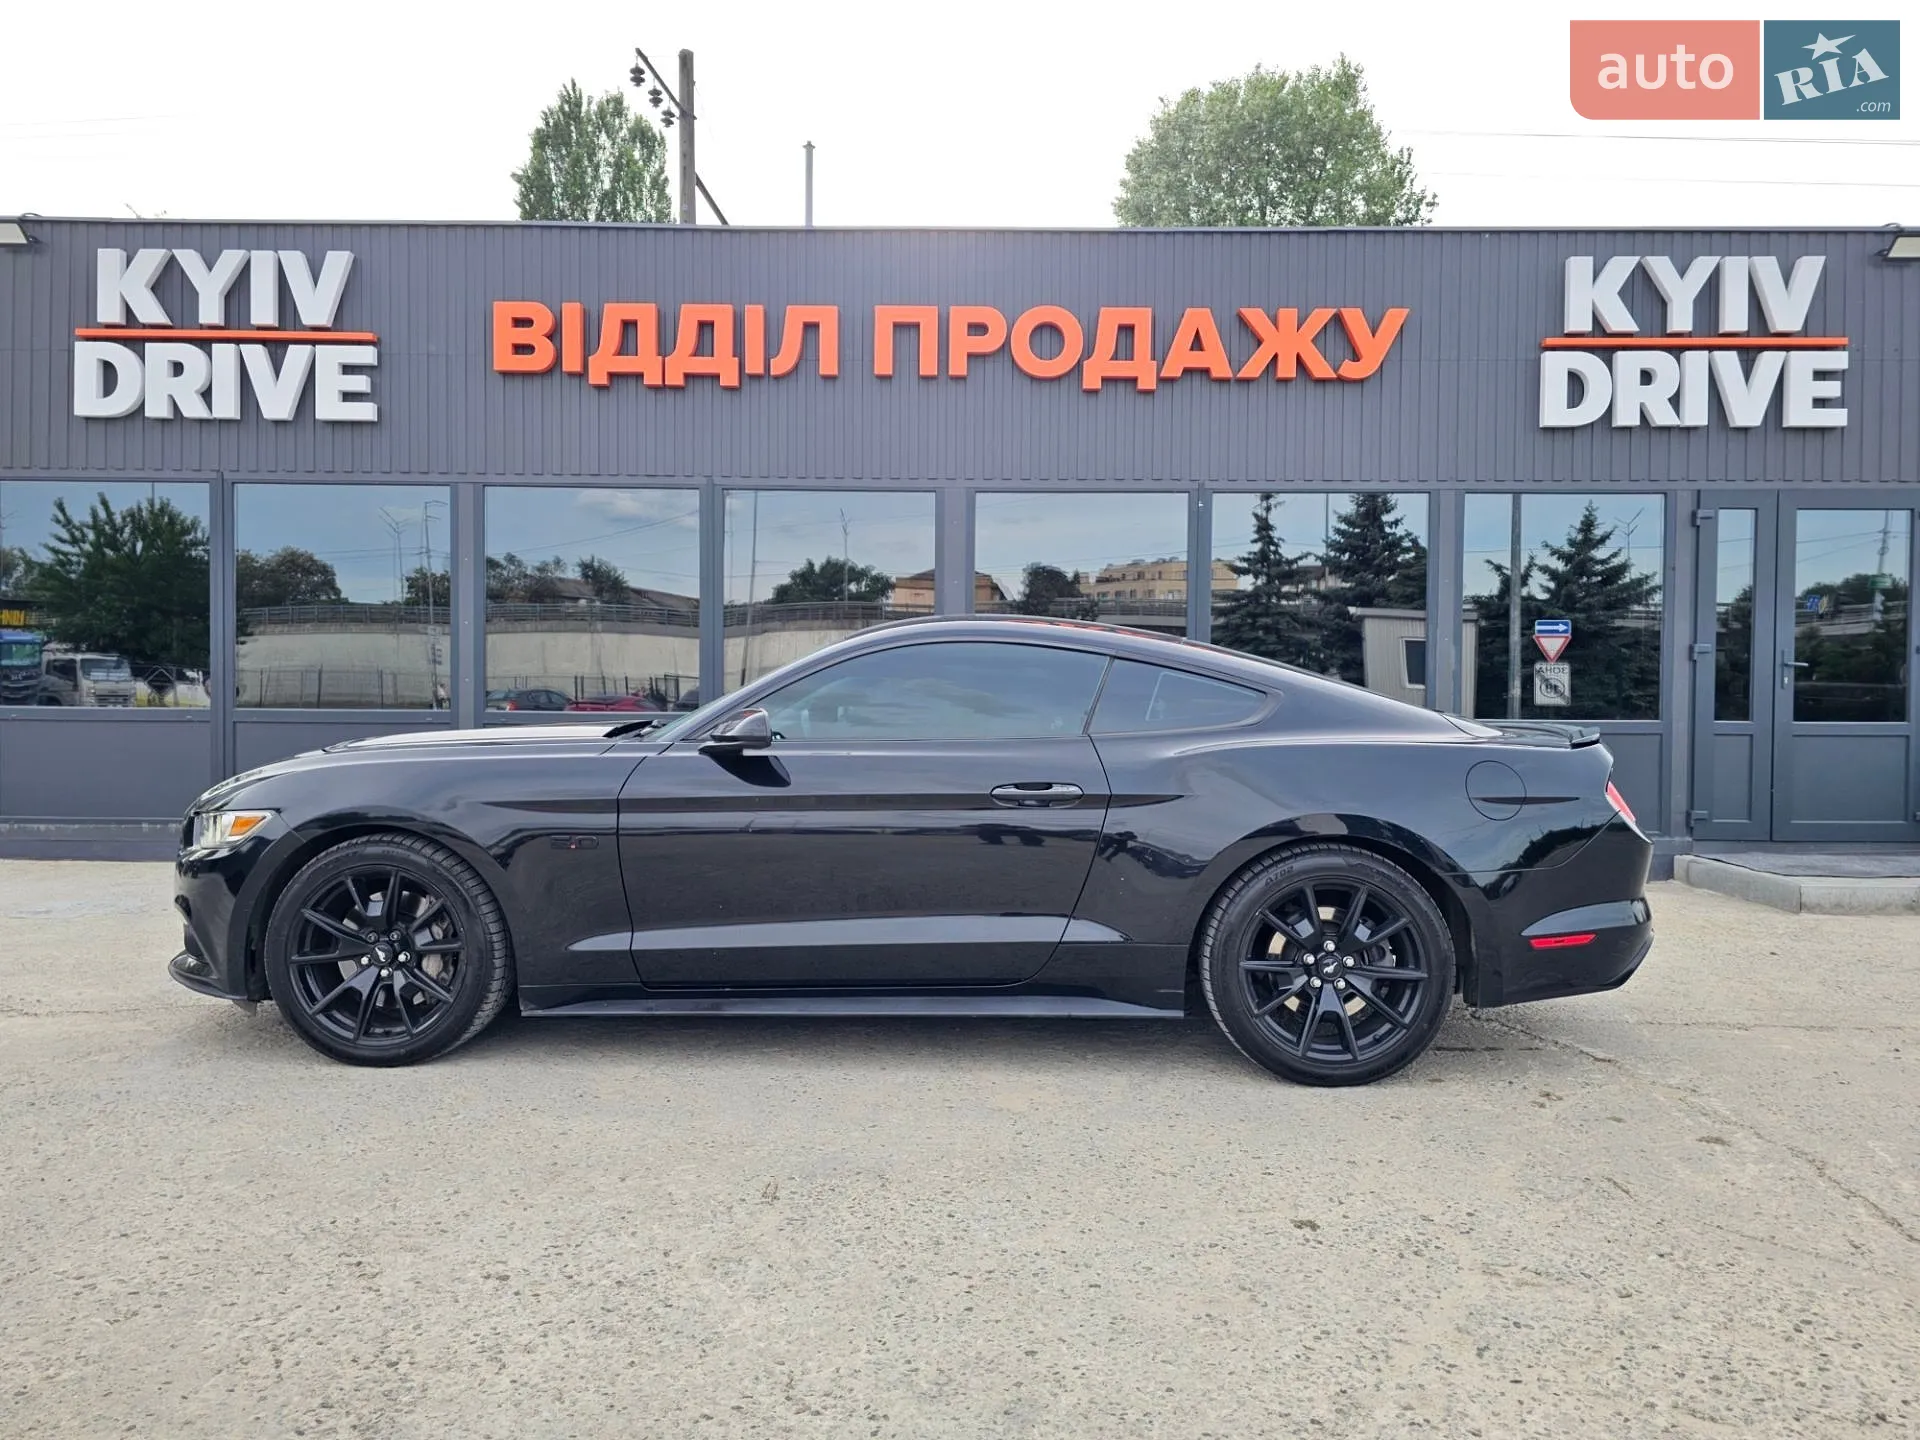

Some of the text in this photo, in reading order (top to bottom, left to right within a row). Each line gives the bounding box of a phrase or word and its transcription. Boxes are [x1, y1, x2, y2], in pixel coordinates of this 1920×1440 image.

[97, 247, 356, 328] KYIV
[1563, 255, 1827, 335] KYIV
[73, 340, 379, 423] DRIVE
[492, 300, 1411, 392] ВІДДІЛ ПРОДАЖУ
[1539, 350, 1849, 429] DRIVE
